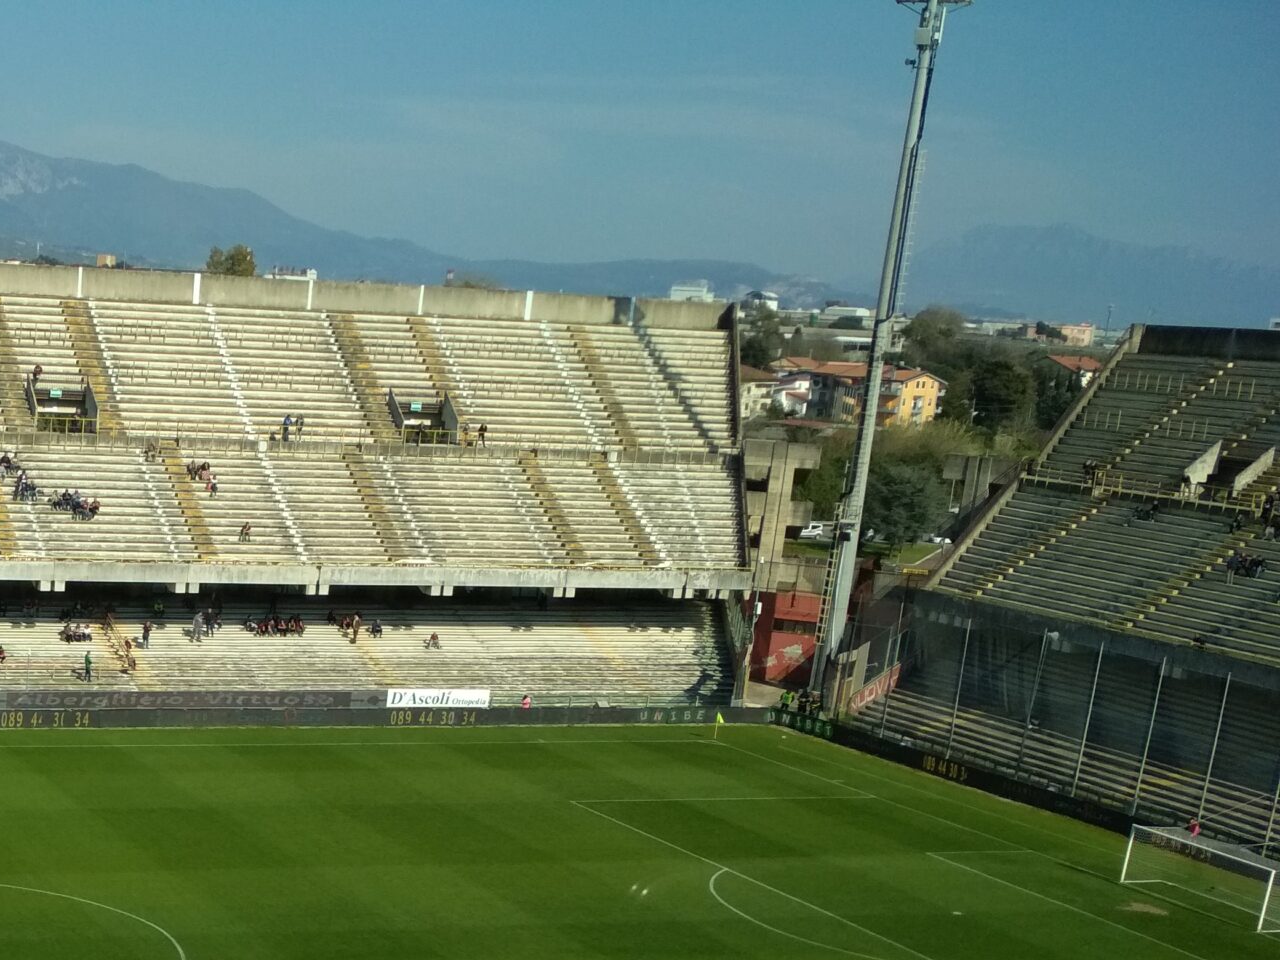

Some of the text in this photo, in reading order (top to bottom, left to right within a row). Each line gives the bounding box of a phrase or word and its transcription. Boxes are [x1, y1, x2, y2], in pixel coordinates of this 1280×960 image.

[1, 712, 23, 727] 089
[74, 712, 90, 727] 34
[390, 711, 476, 725] 089 44 30 34
